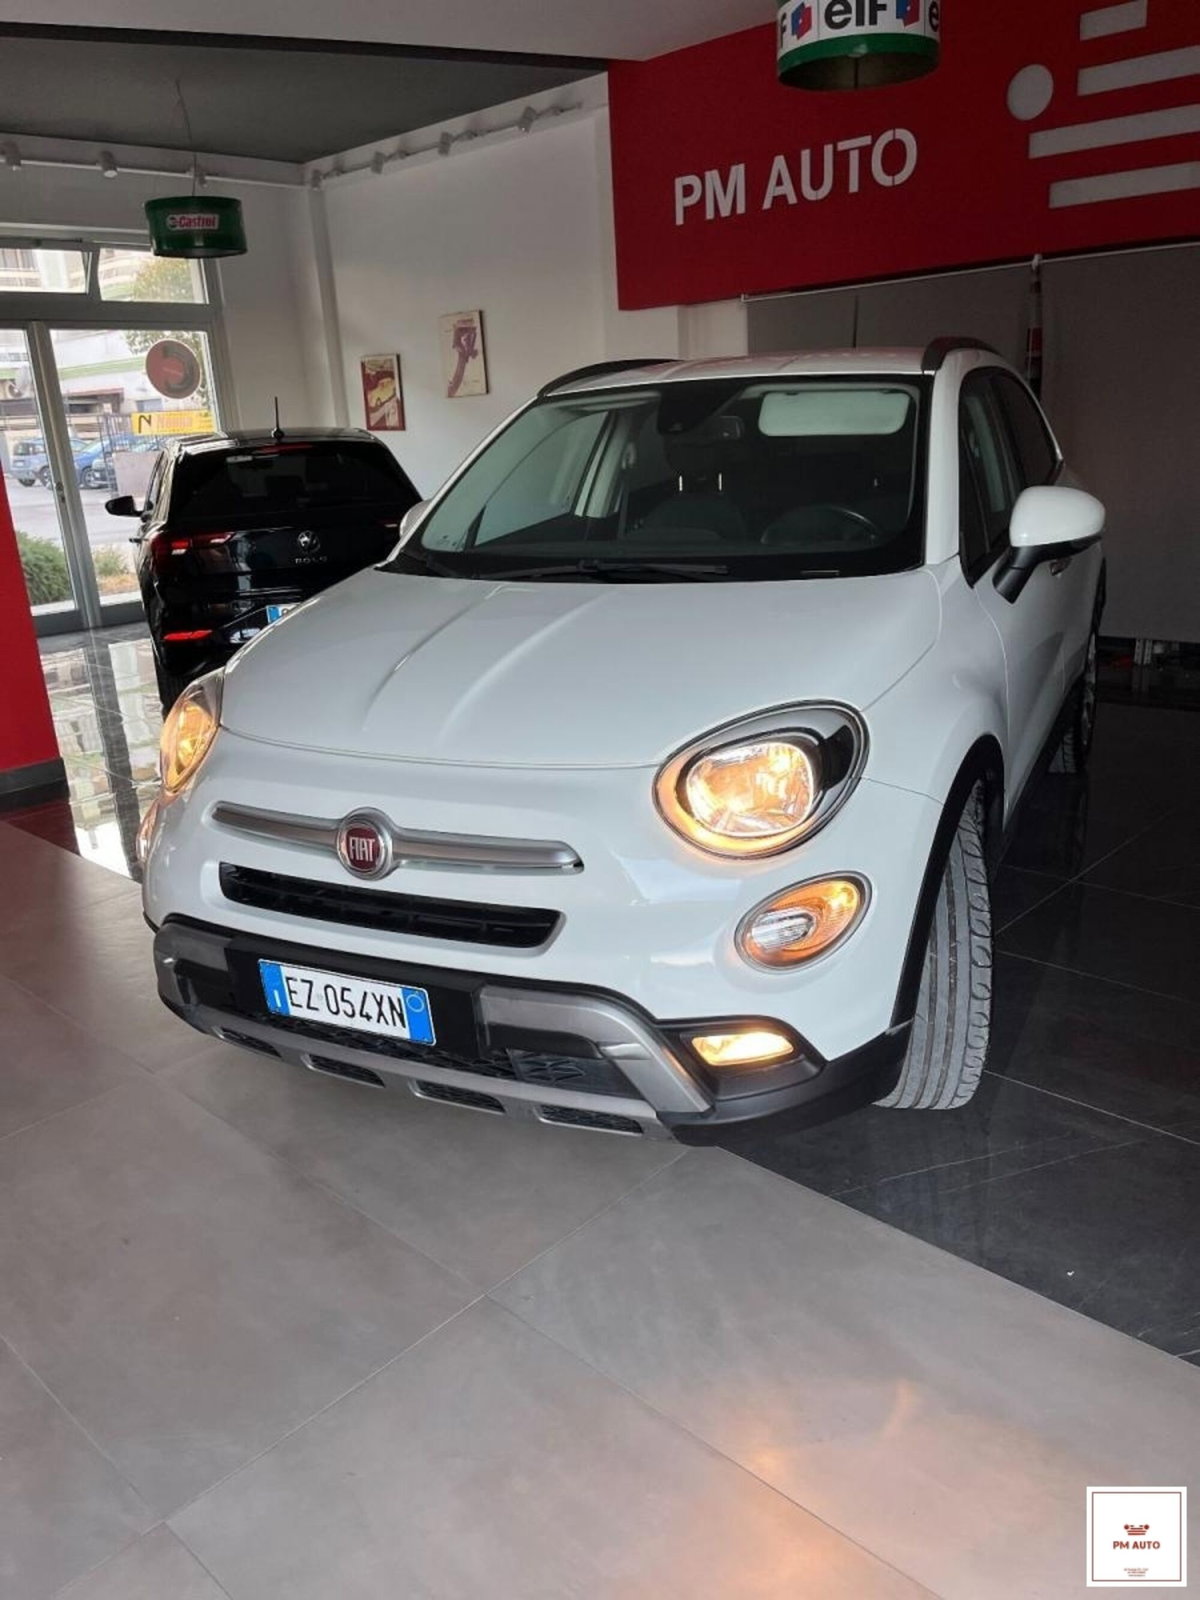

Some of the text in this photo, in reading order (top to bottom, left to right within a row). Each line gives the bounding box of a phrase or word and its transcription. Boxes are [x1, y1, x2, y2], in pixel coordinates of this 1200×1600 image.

[674, 128, 918, 226] PM AUTO
[179, 216, 216, 228] Castrol
[348, 836, 376, 862] FIAT
[285, 976, 319, 1011] EZ
[323, 984, 407, 1029] 054XN
